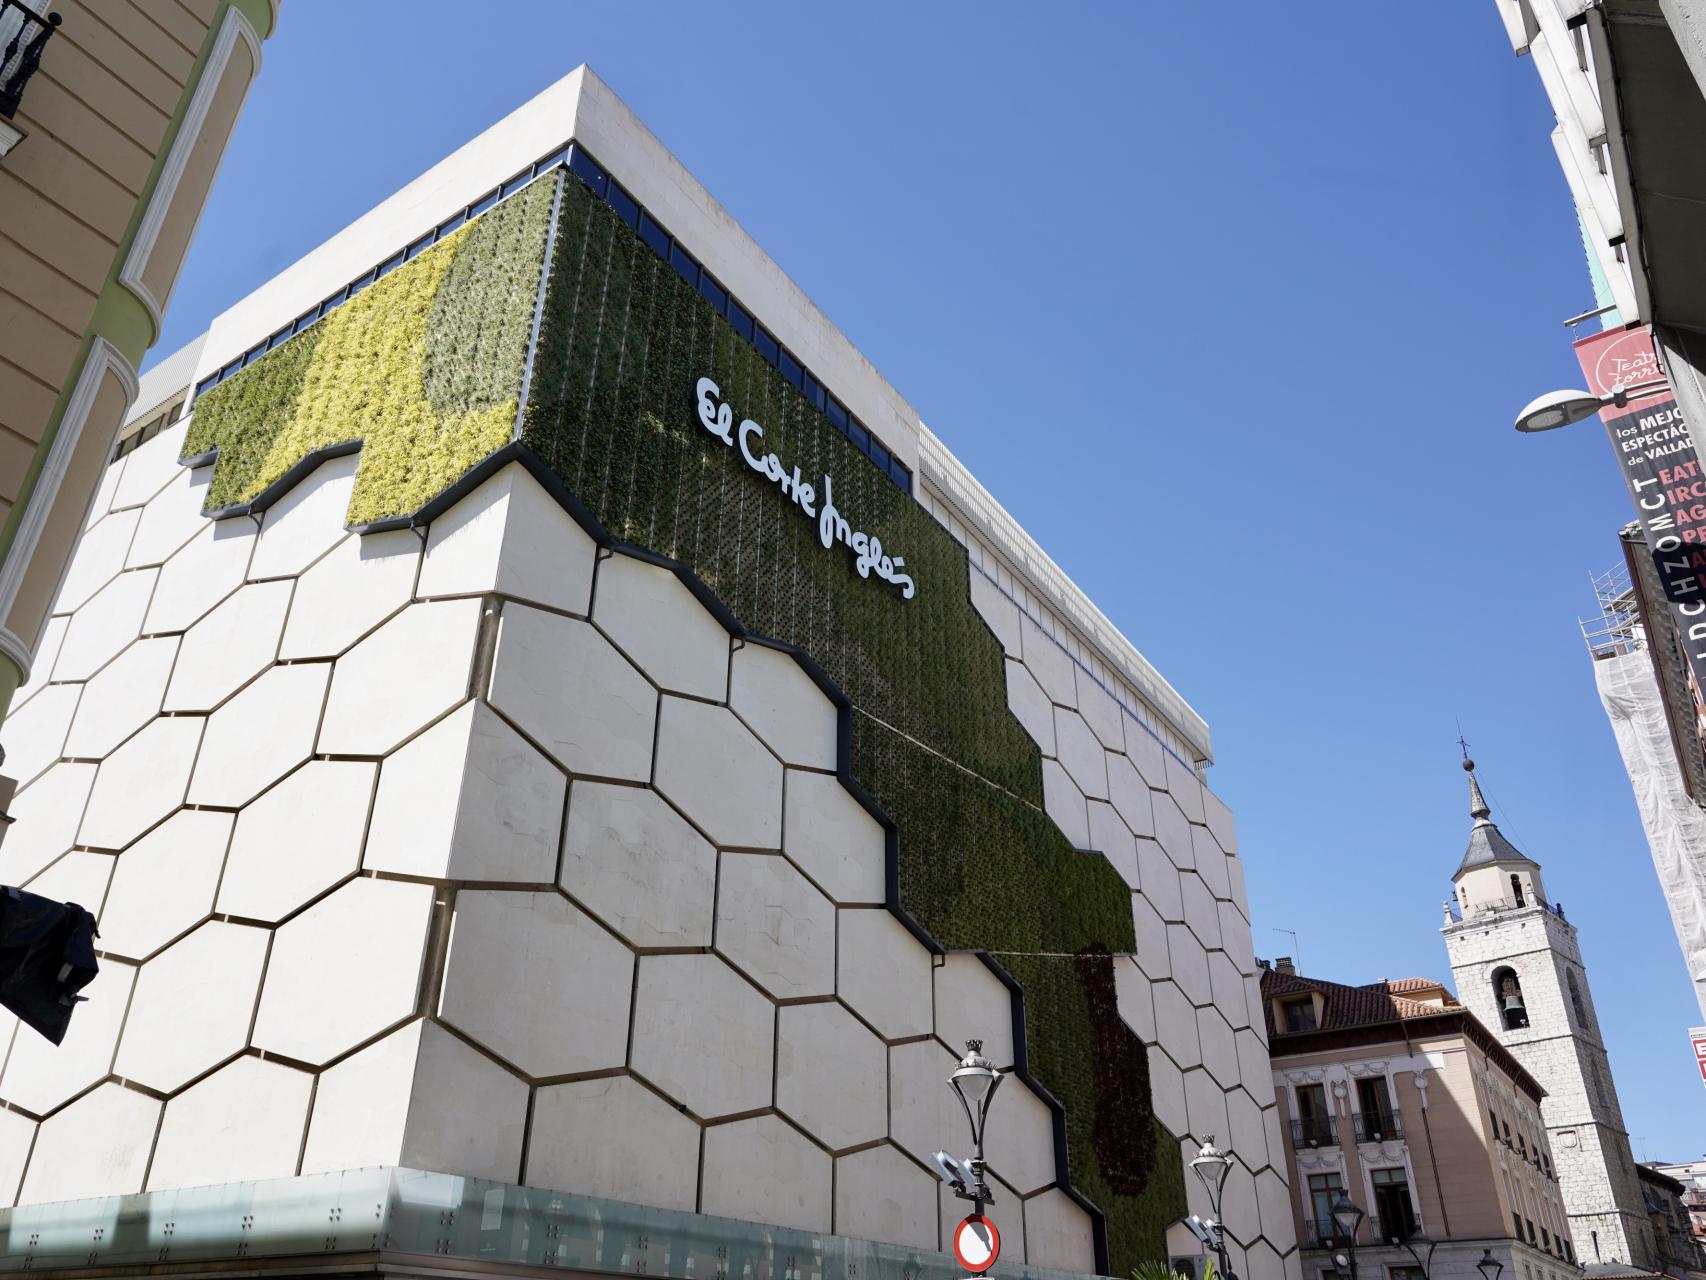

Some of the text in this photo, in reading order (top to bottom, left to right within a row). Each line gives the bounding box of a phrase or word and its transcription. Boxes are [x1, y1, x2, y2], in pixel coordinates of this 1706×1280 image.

[1616, 426, 1638, 438] los
[1627, 455, 1645, 466] de
[1659, 460, 1704, 485] EAT
[696, 377, 915, 599] El Corte Inglés
[1666, 481, 1706, 505] IRC
